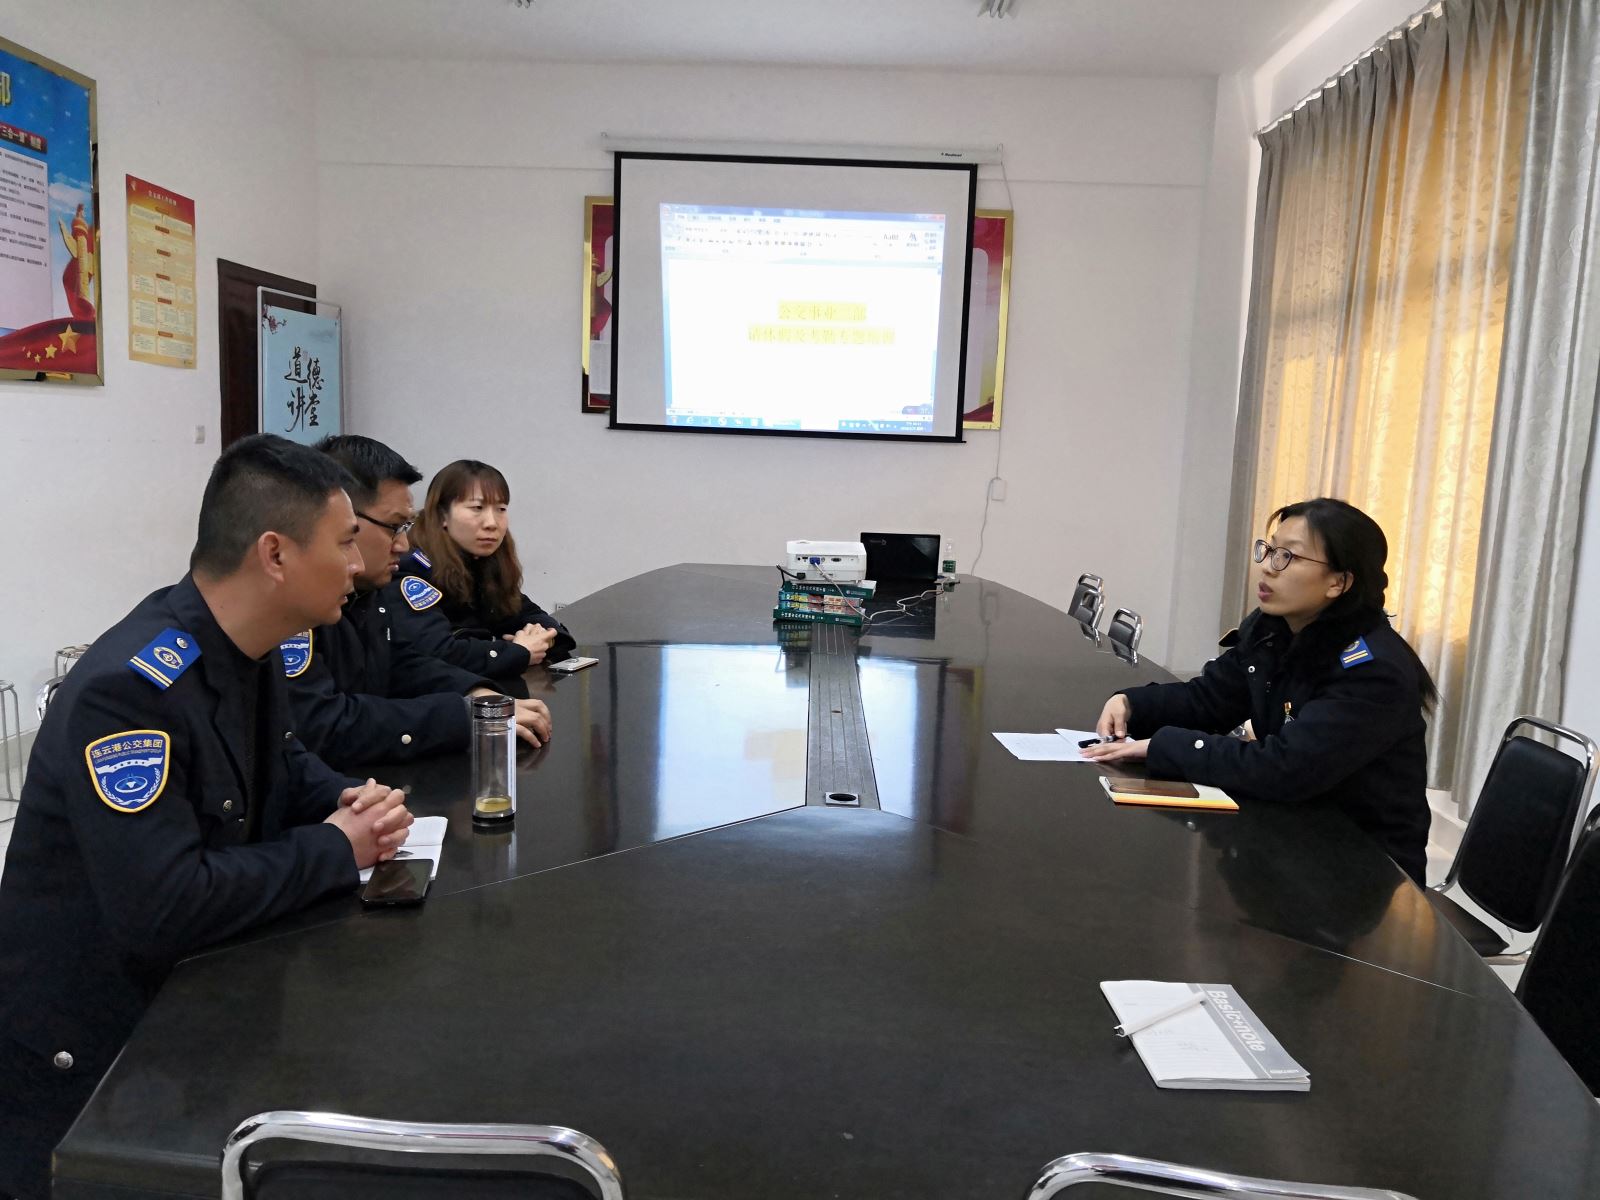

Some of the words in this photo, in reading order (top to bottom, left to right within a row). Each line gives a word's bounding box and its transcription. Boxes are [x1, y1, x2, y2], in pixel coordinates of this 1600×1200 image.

[91, 739, 163, 758] 连云港公交集团
